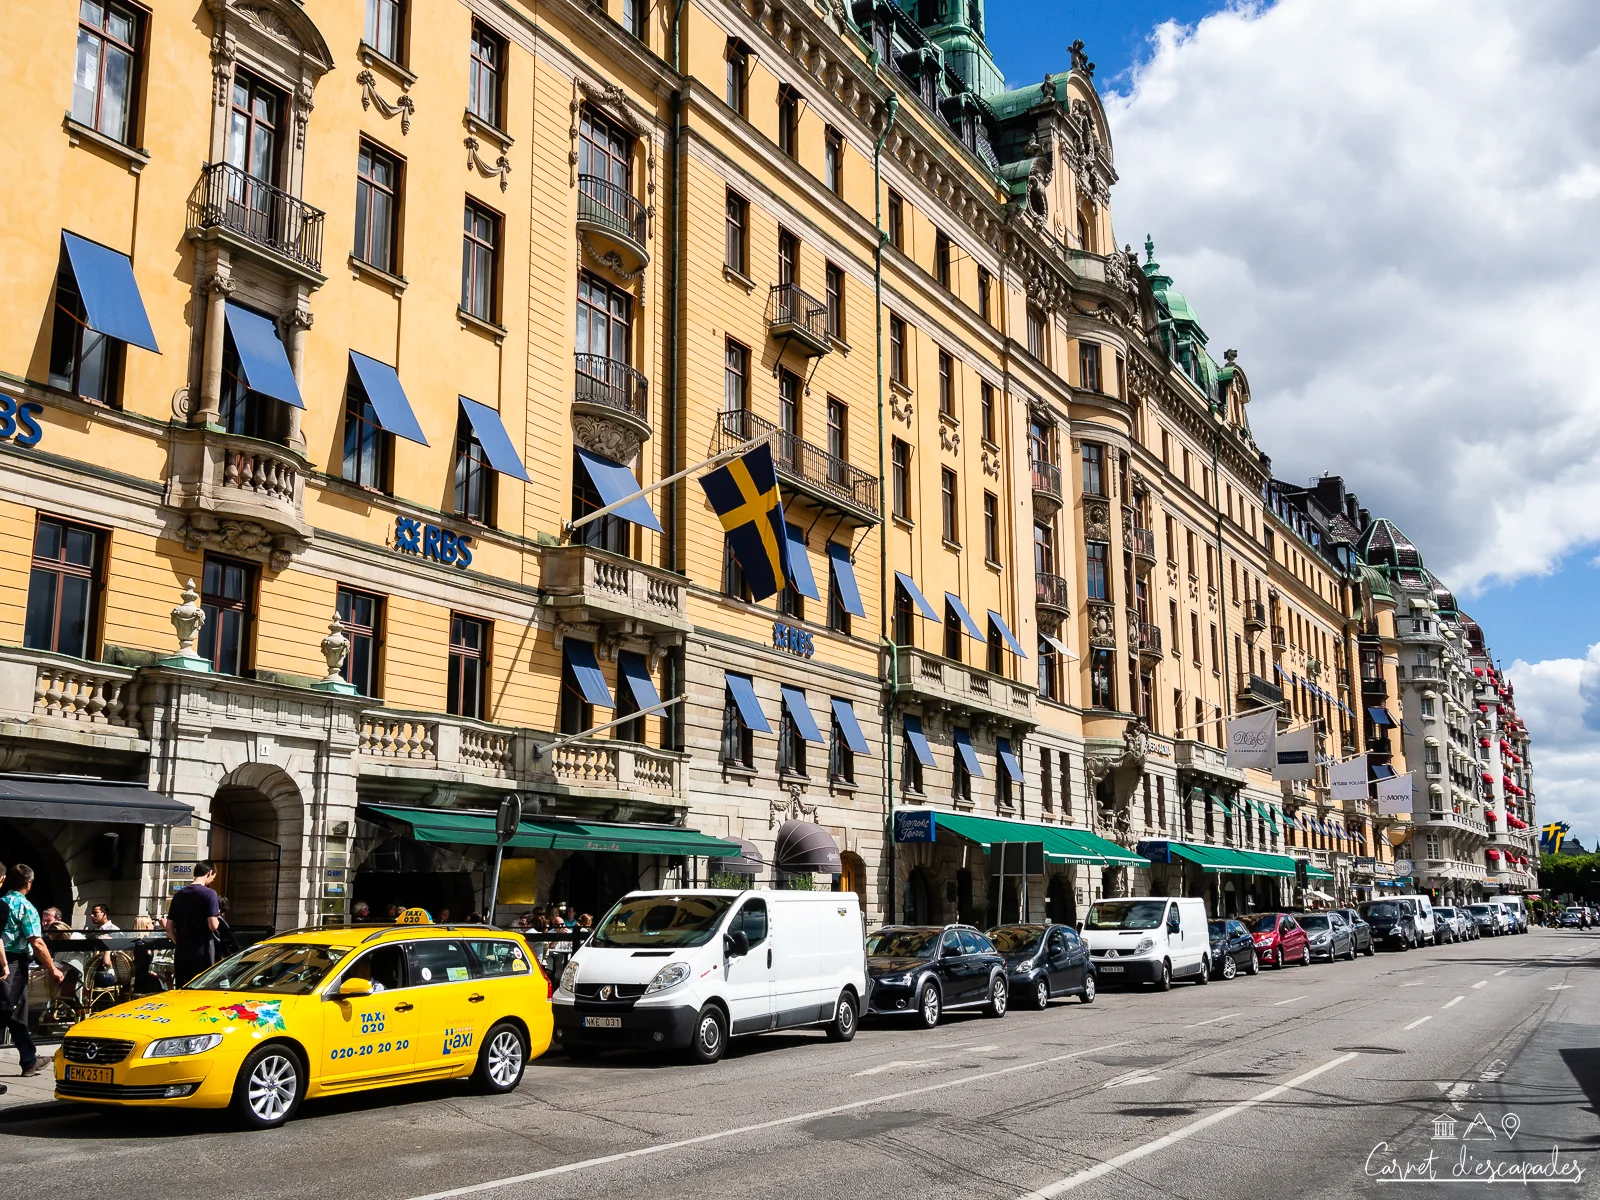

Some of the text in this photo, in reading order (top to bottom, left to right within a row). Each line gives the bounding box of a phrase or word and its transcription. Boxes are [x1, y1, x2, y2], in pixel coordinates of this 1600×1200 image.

[425, 523, 473, 567] RBS
[789, 626, 815, 656] RBS
[897, 813, 930, 830] Svenskt
[900, 827, 926, 841] Tenn
[361, 1022, 385, 1034] 020
[586, 1017, 620, 1027] NKE 031
[331, 1039, 410, 1060] 020-20 20 20
[70, 1067, 104, 1081] EMK231
